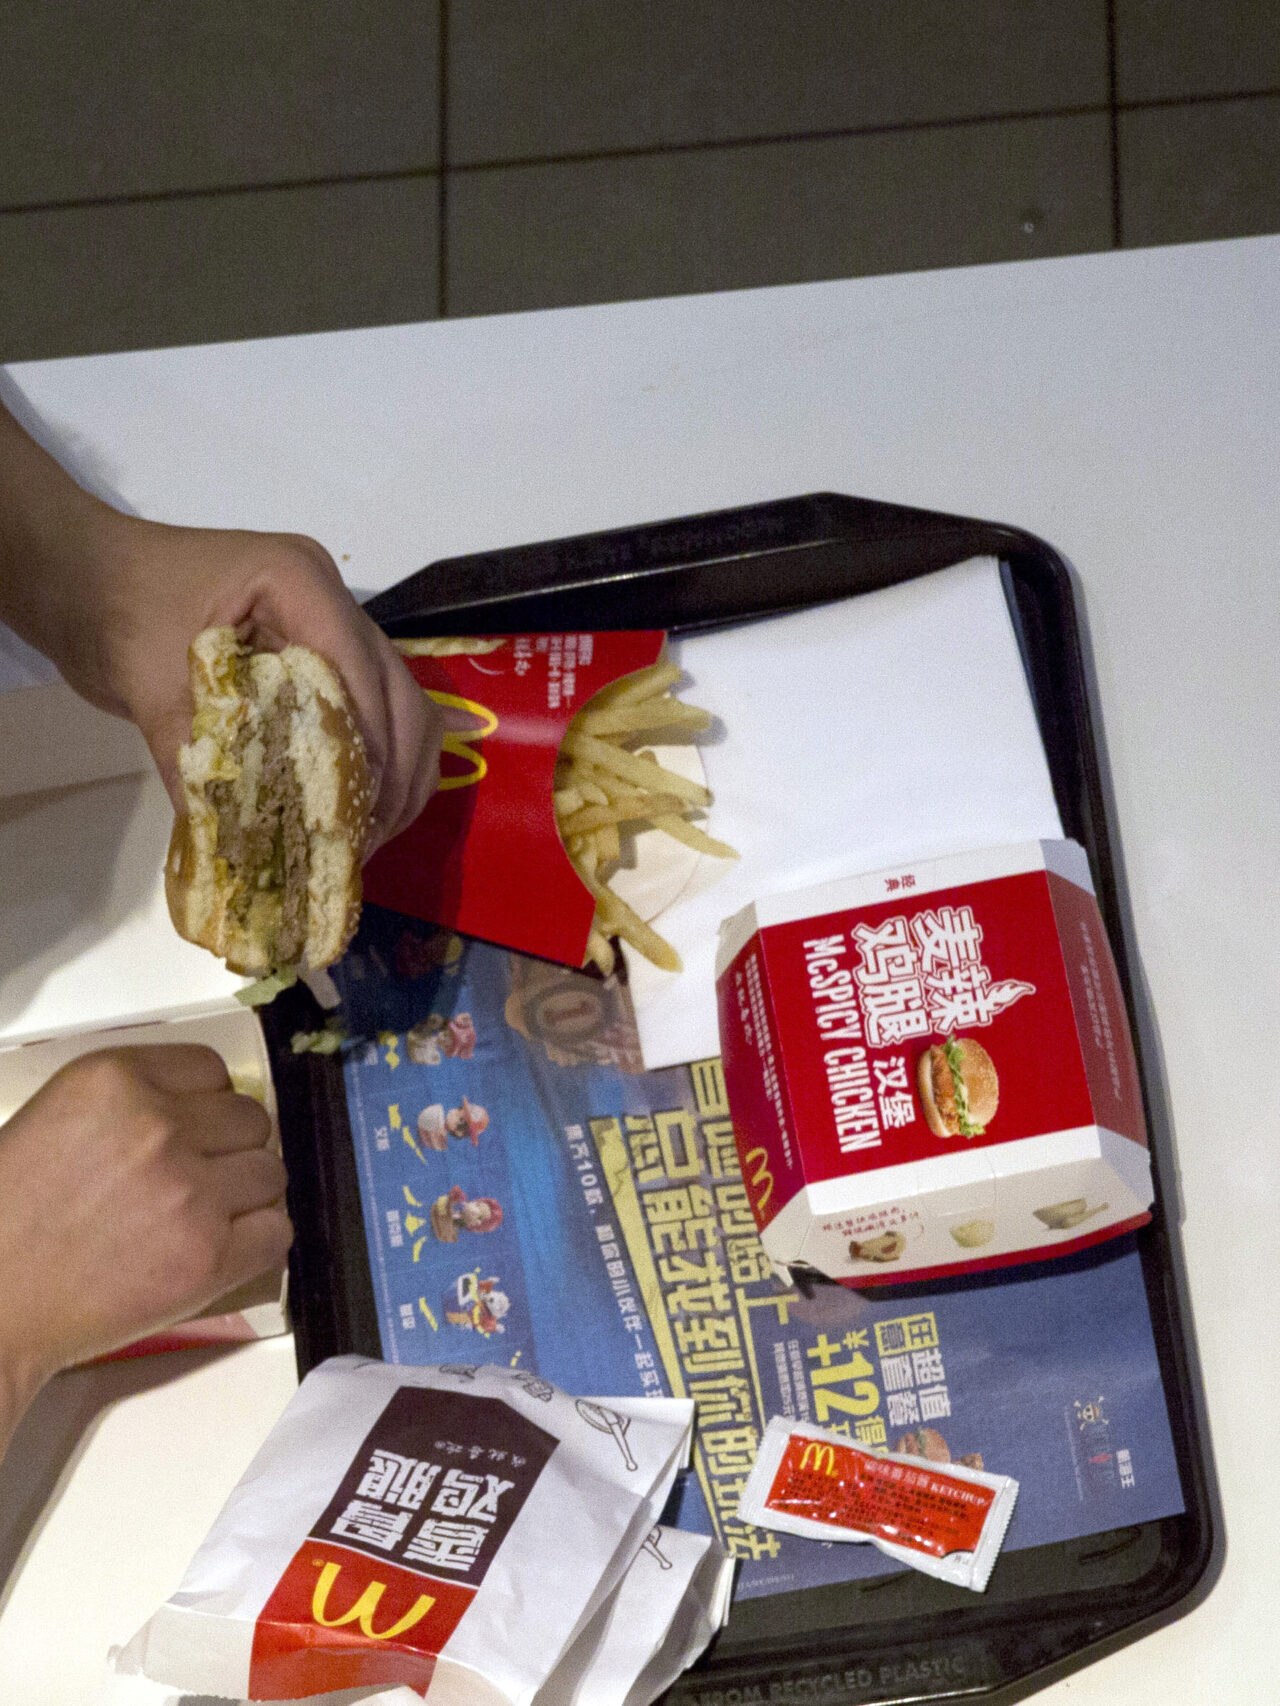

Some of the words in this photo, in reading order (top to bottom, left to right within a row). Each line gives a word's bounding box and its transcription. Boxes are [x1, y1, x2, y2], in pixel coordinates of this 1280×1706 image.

[886, 874, 916, 892] 经典
[803, 933, 863, 1041] McSPICY
[851, 915, 932, 1048] 鸡腿
[912, 905, 996, 1035] 麦辣
[824, 1046, 883, 1154] CHICKEN
[873, 1056, 916, 1131] 汉堡
[876, 1313, 938, 1356] 任意
[880, 1356, 920, 1427] 套餐
[912, 1348, 951, 1421] 超值
[356, 1449, 516, 1523] 鸡腿
